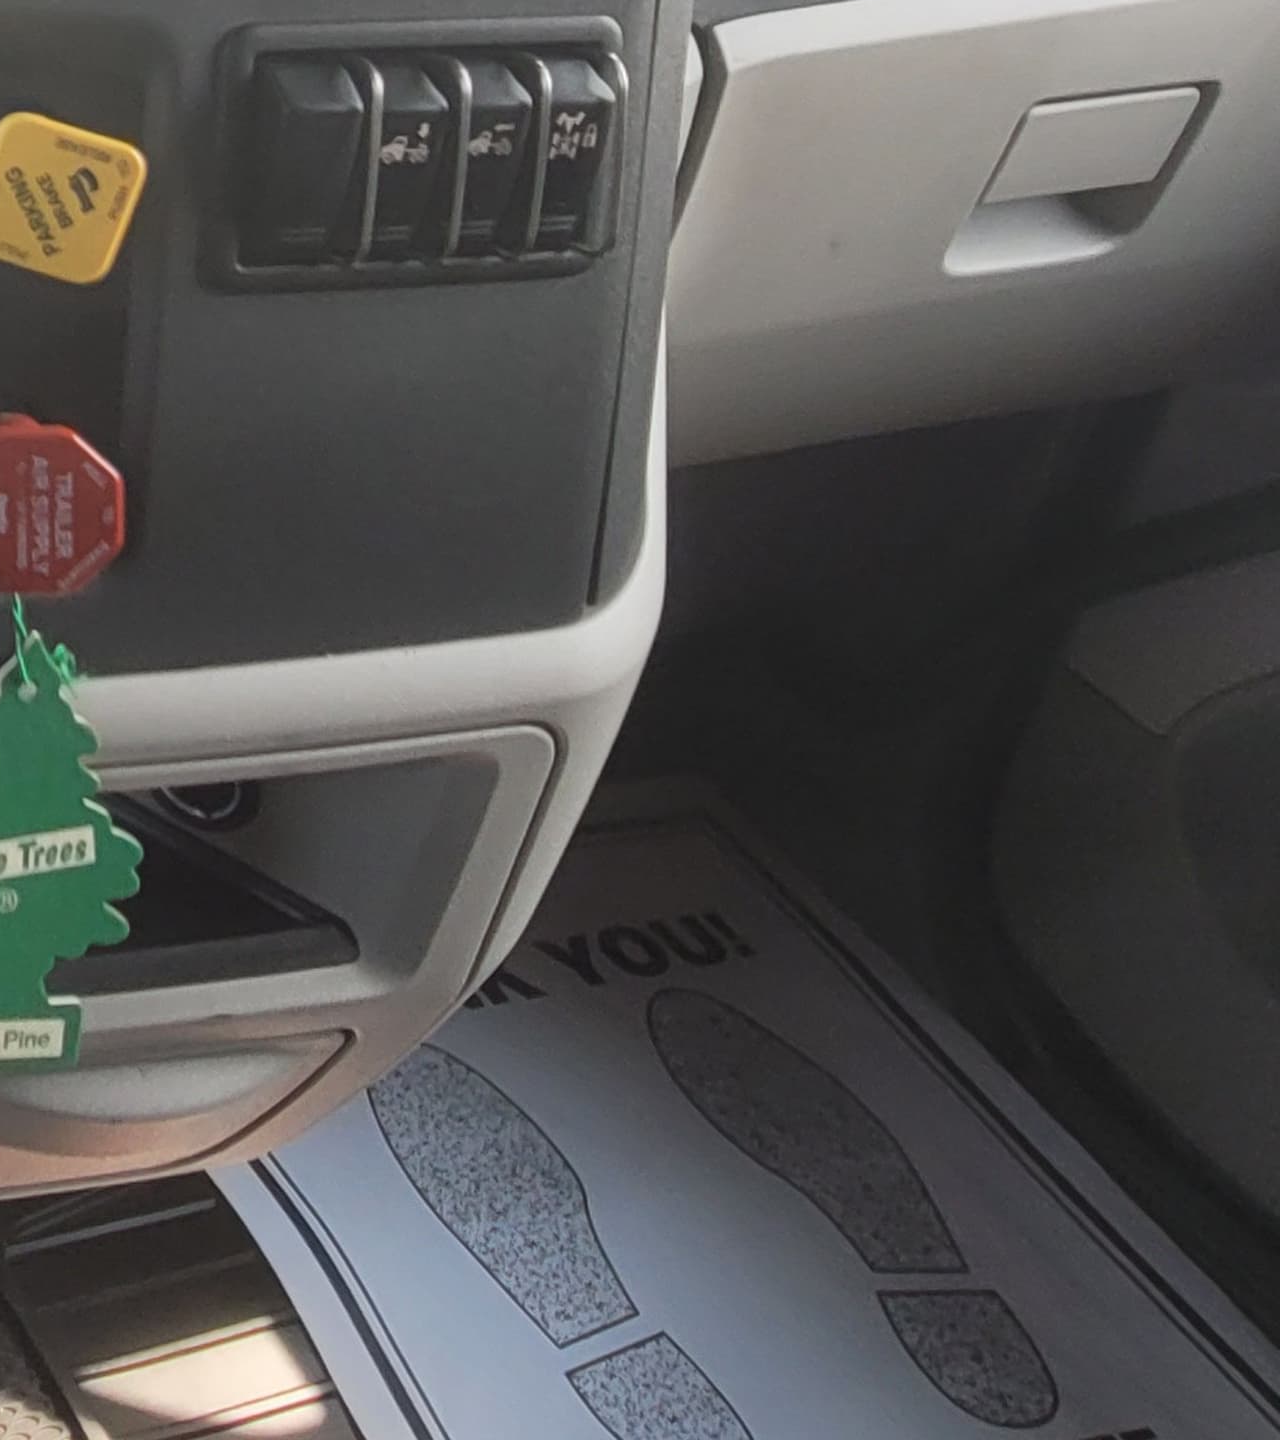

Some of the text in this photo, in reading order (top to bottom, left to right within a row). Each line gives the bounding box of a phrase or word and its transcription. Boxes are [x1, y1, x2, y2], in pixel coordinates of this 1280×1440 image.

[4, 165, 64, 258] PARKING
[36, 171, 74, 230] BRAKE
[32, 455, 49, 576] AIR SUPPLY
[55, 472, 74, 559] TRAILER
[18, 839, 88, 870] Trees
[532, 912, 758, 986] YOU!
[3, 1030, 51, 1050] Pine
